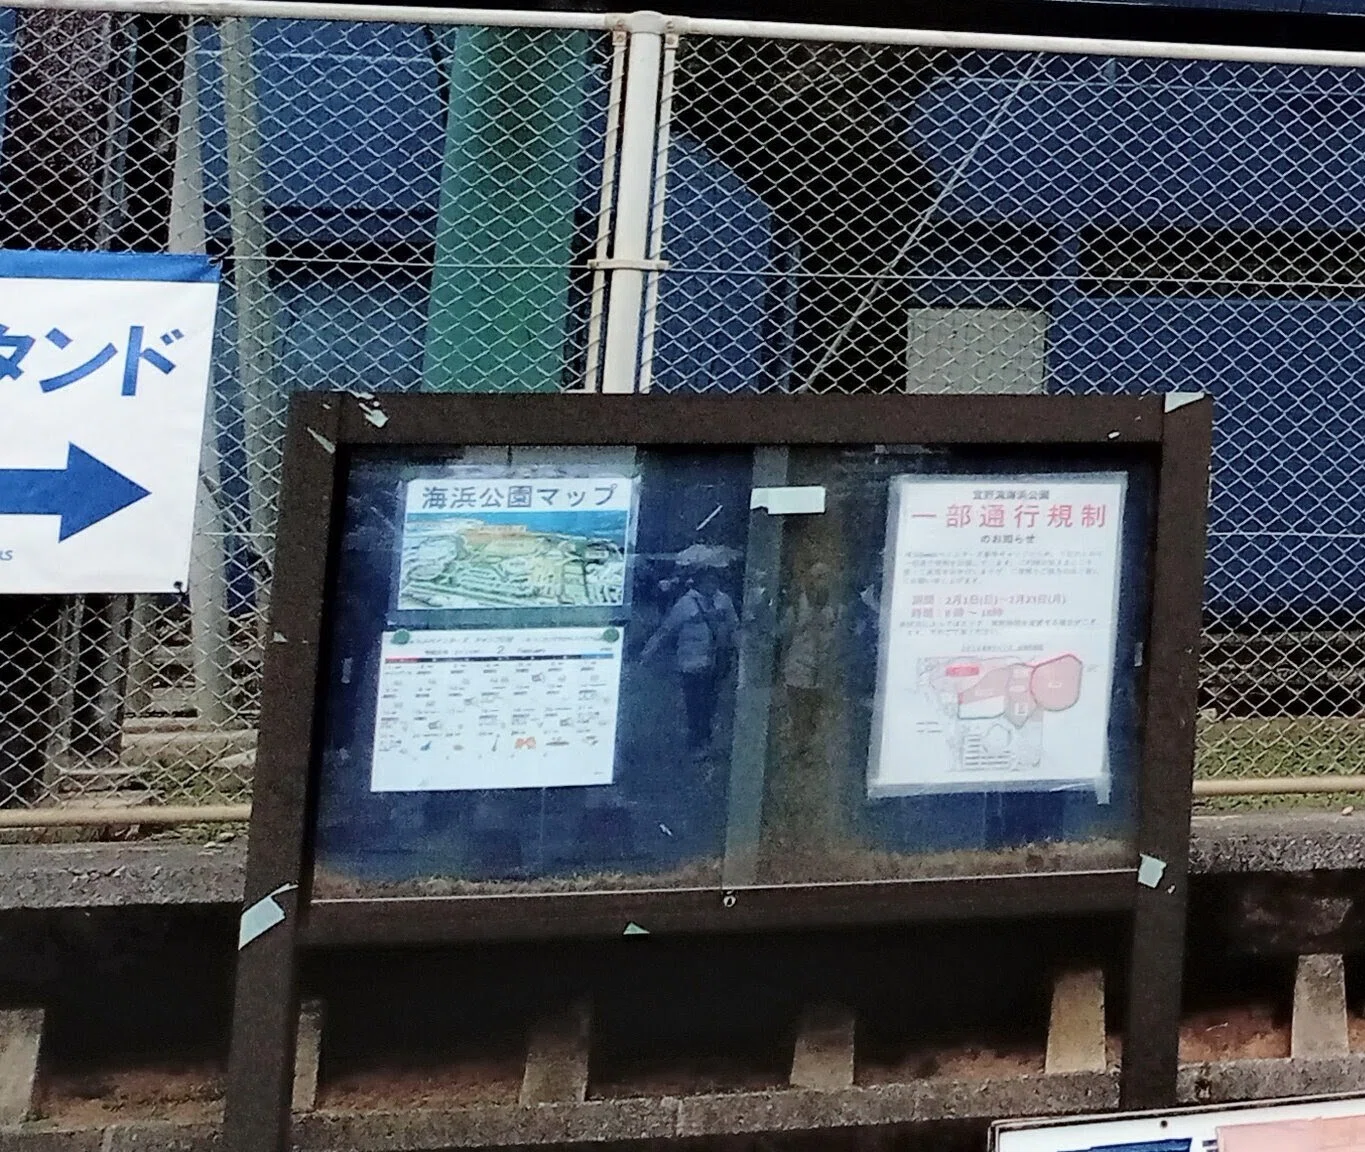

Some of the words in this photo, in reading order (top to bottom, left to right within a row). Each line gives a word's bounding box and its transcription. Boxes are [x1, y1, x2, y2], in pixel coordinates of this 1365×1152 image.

[422, 483, 618, 510] 海浜公園マップ
[911, 503, 1106, 529] 一部通行規制
[980, 533, 1036, 545] のお知らせ
